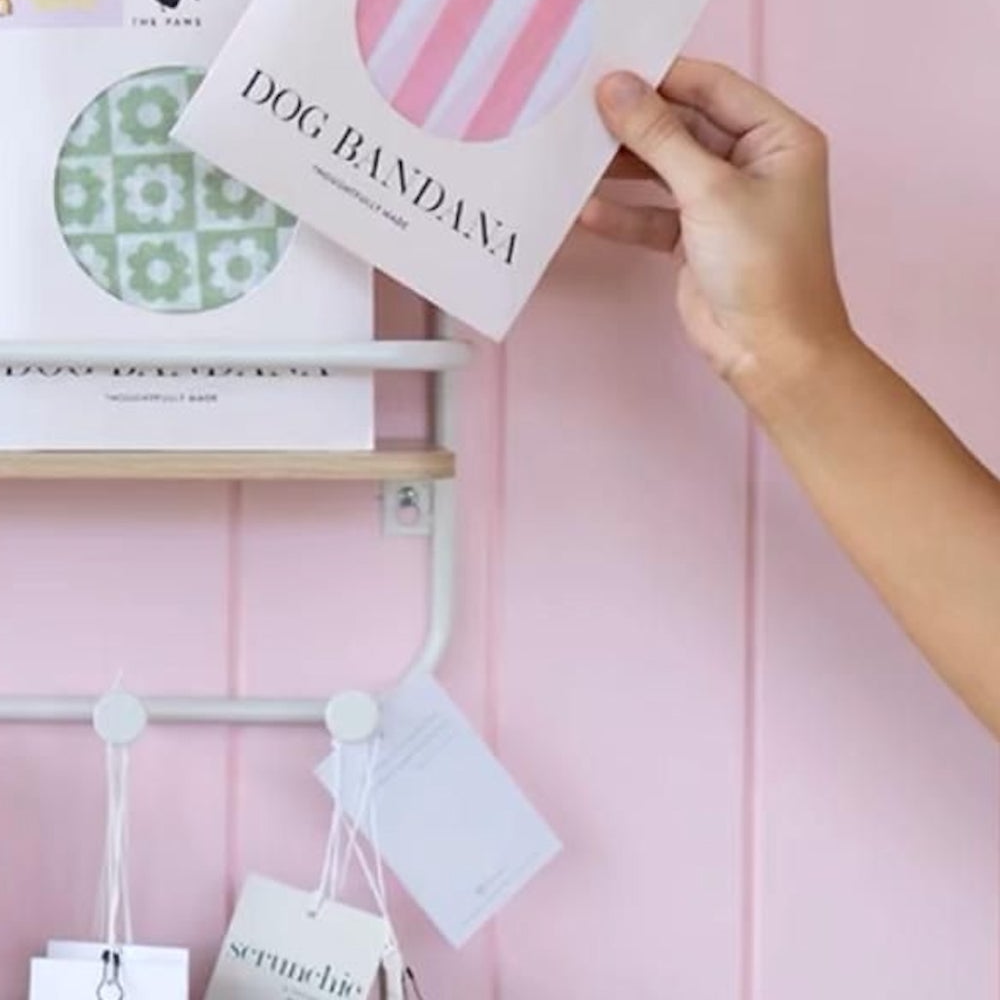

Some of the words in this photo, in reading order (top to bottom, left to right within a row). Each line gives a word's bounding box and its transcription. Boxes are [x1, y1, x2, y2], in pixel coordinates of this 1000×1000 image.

[241, 69, 329, 139] DOG
[332, 126, 517, 264] BANDANA
[227, 941, 363, 998] scrunchie
